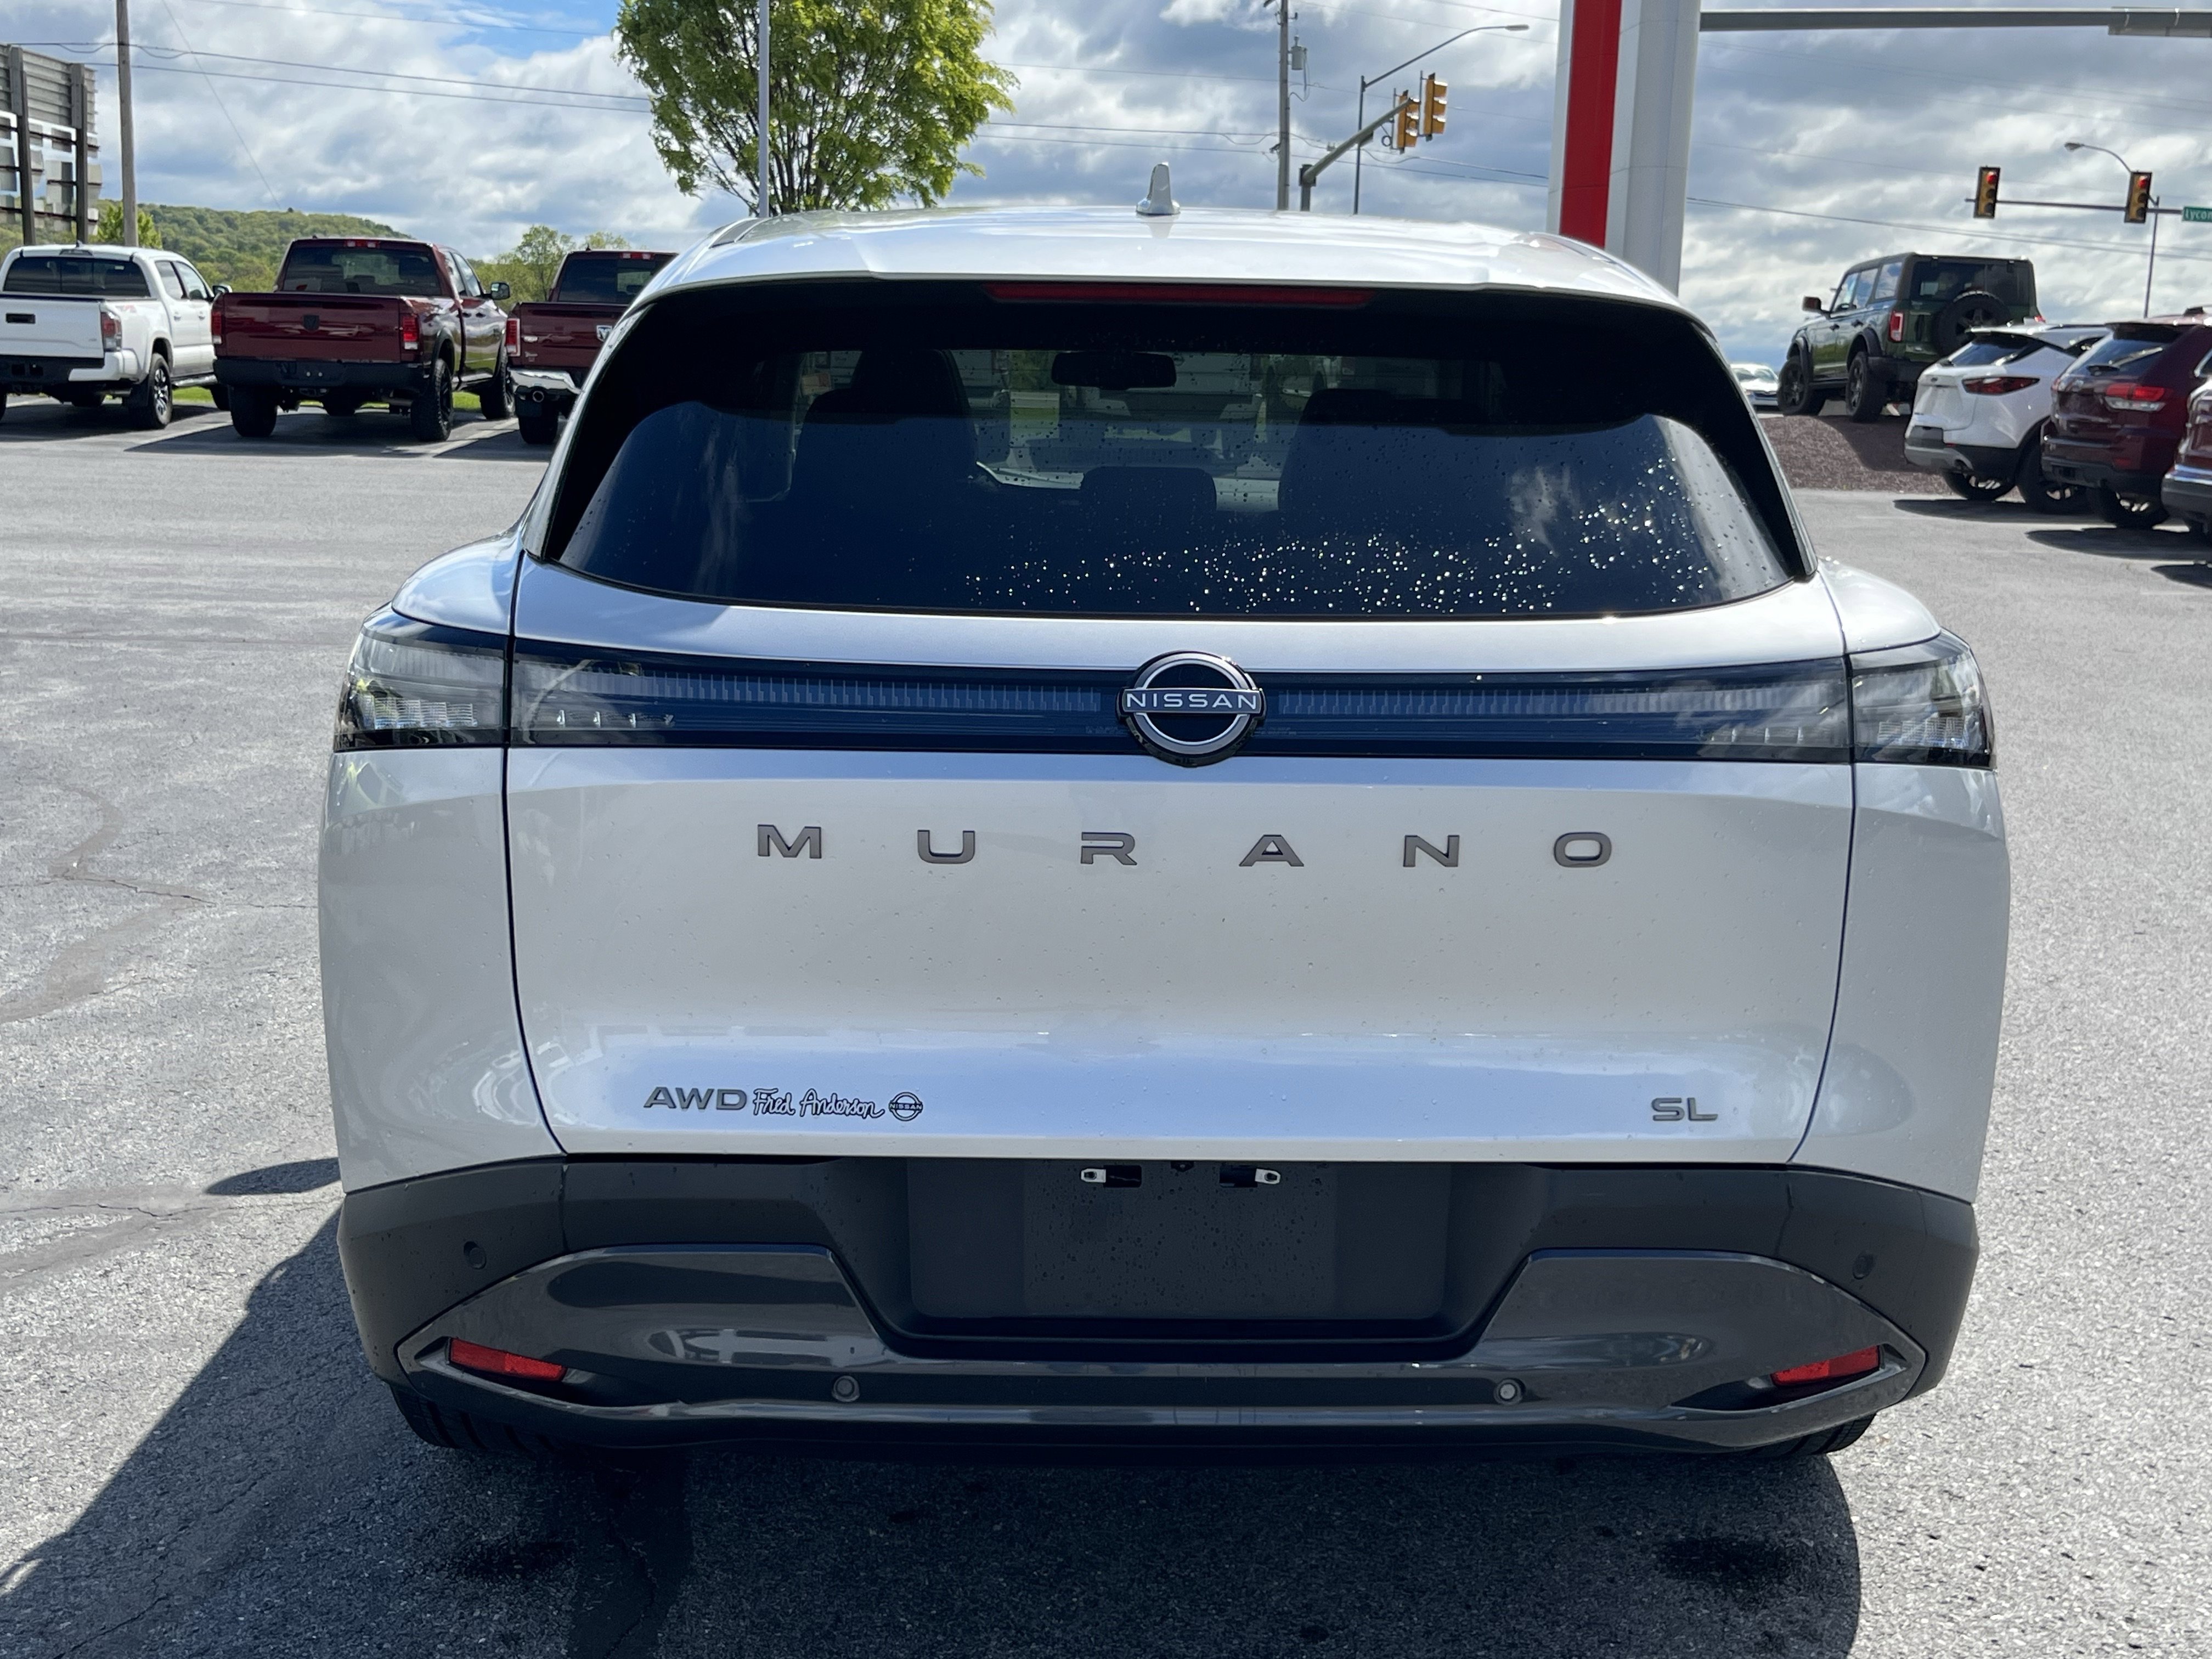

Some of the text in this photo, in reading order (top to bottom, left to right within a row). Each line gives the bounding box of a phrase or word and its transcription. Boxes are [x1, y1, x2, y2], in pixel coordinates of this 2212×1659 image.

[1126, 692, 1257, 710] NISSAN
[757, 824, 1612, 867] MURANO
[644, 1086, 747, 1110] AWD
[753, 1088, 885, 1119] Fred Anderson
[888, 1102, 923, 1110] NISSAN
[1651, 1097, 1718, 1121] SL
